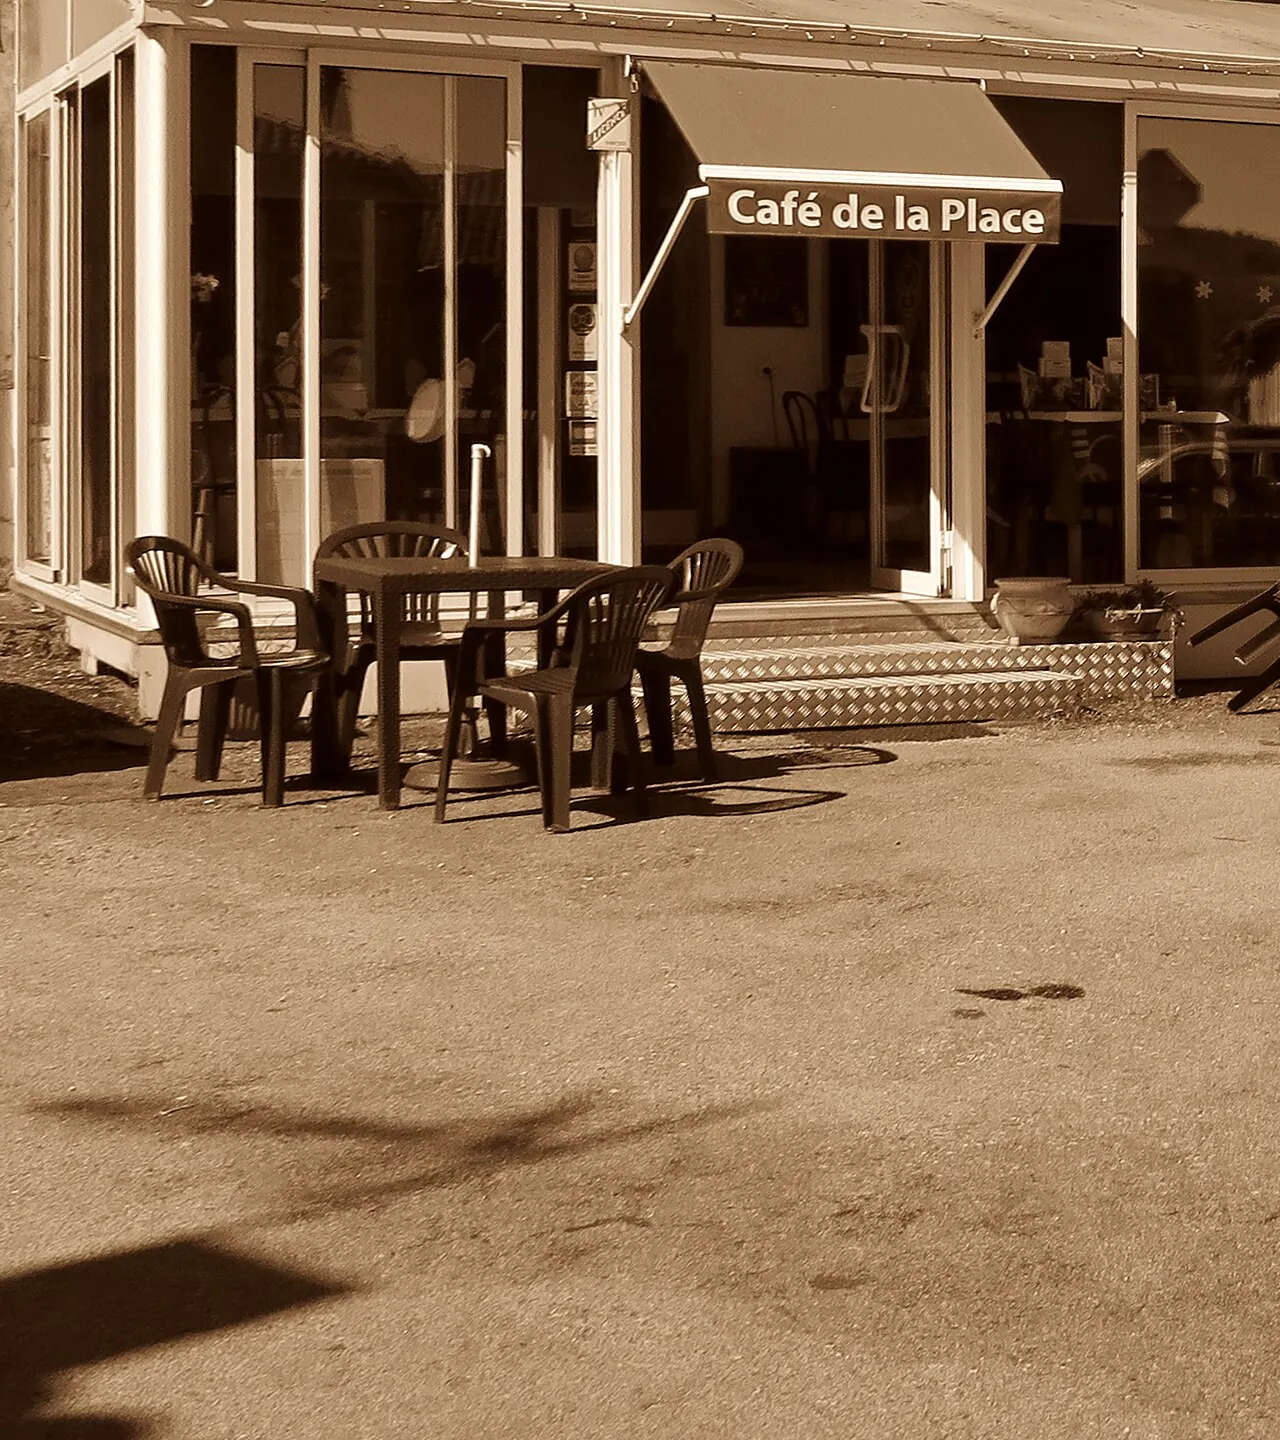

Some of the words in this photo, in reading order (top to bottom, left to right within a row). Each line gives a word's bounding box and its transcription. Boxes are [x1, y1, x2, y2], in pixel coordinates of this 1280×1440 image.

[727, 189, 822, 227] Café
[832, 193, 884, 230] de
[895, 194, 931, 232] la
[941, 198, 1045, 234] Place
